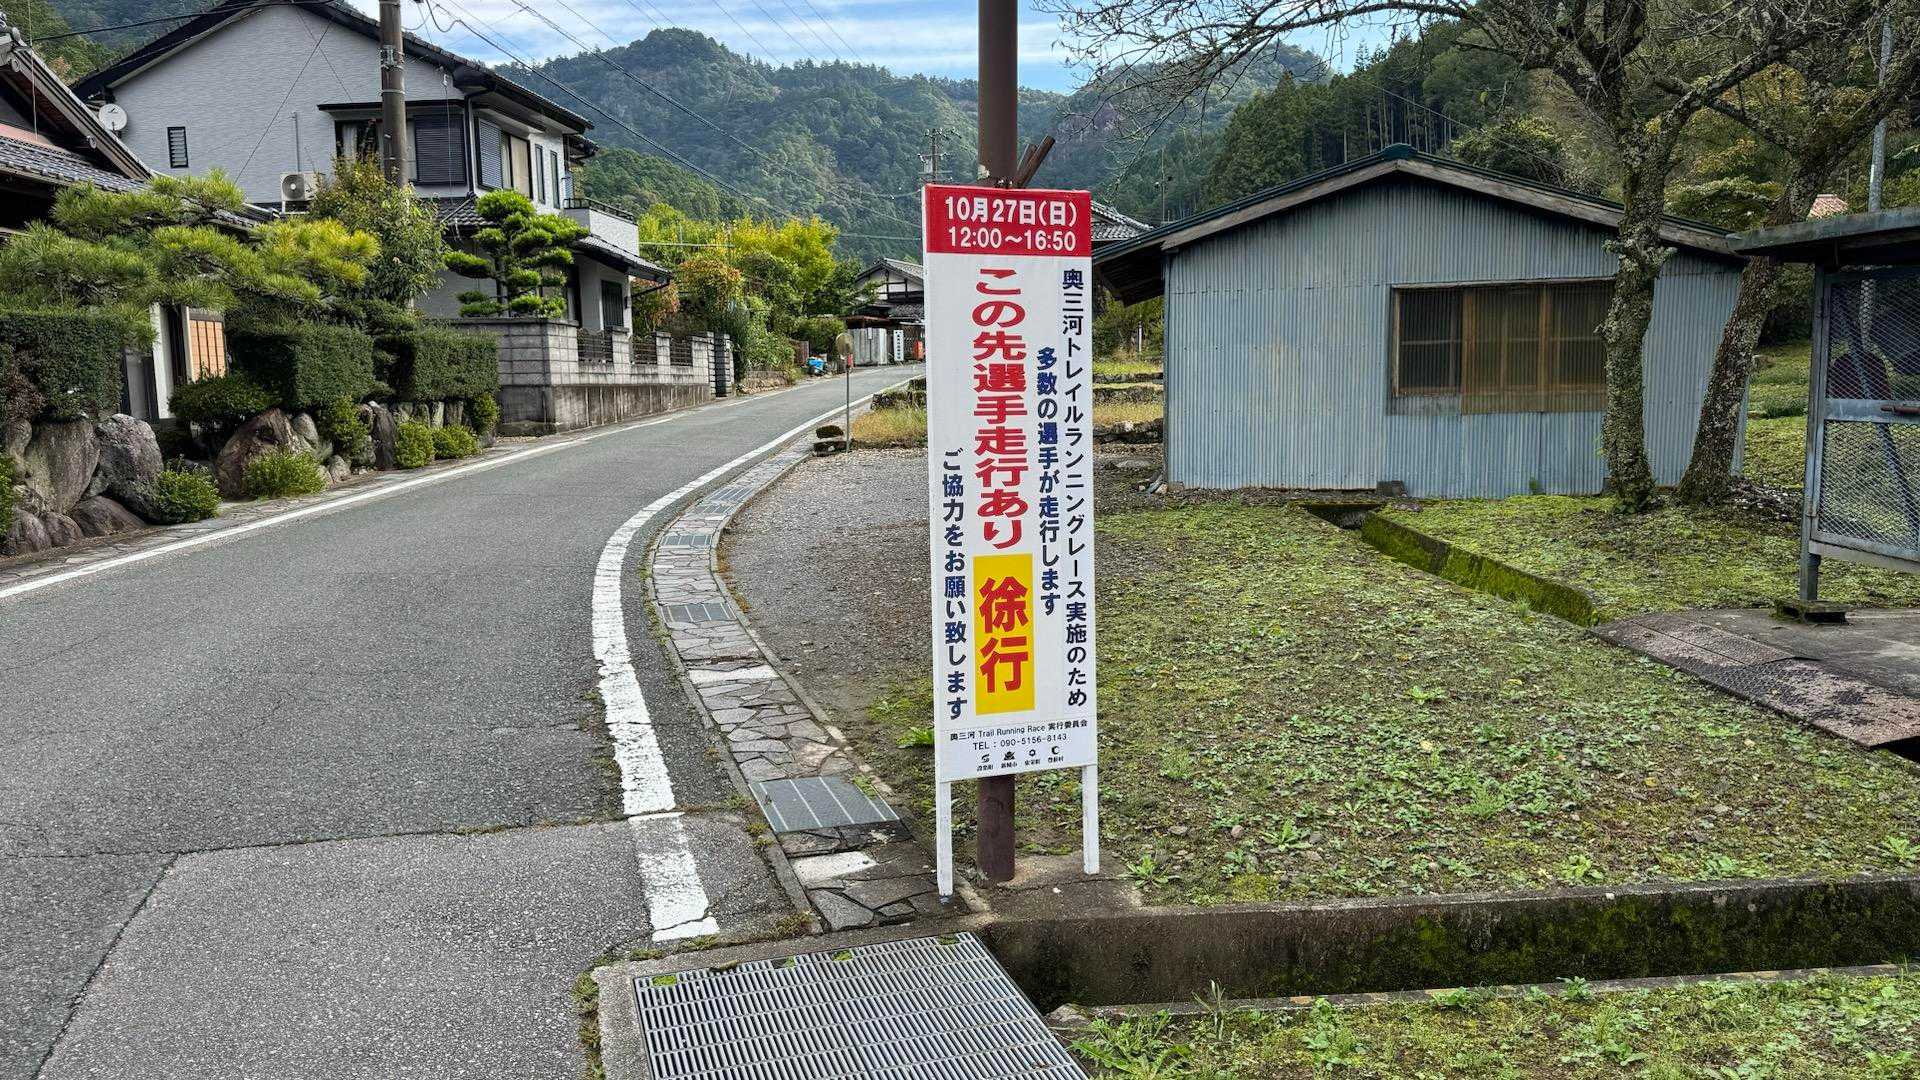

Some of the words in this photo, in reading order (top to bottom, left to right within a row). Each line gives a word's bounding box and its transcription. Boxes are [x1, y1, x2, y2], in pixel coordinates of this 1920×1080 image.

[945, 196, 1077, 227] 10月27日(日)
[972, 268, 1029, 549] この先選手走行あり
[1036, 346, 1060, 616] 多数の選手が走行します
[1062, 268, 1087, 707] 奥三河トレイルランニングレース実施のため
[942, 447, 968, 720] ご協力をお願い致します
[979, 576, 1029, 693] 徐行
[978, 729, 994, 738] Trail
[997, 727, 1025, 737] Running
[1027, 725, 1045, 733] Race
